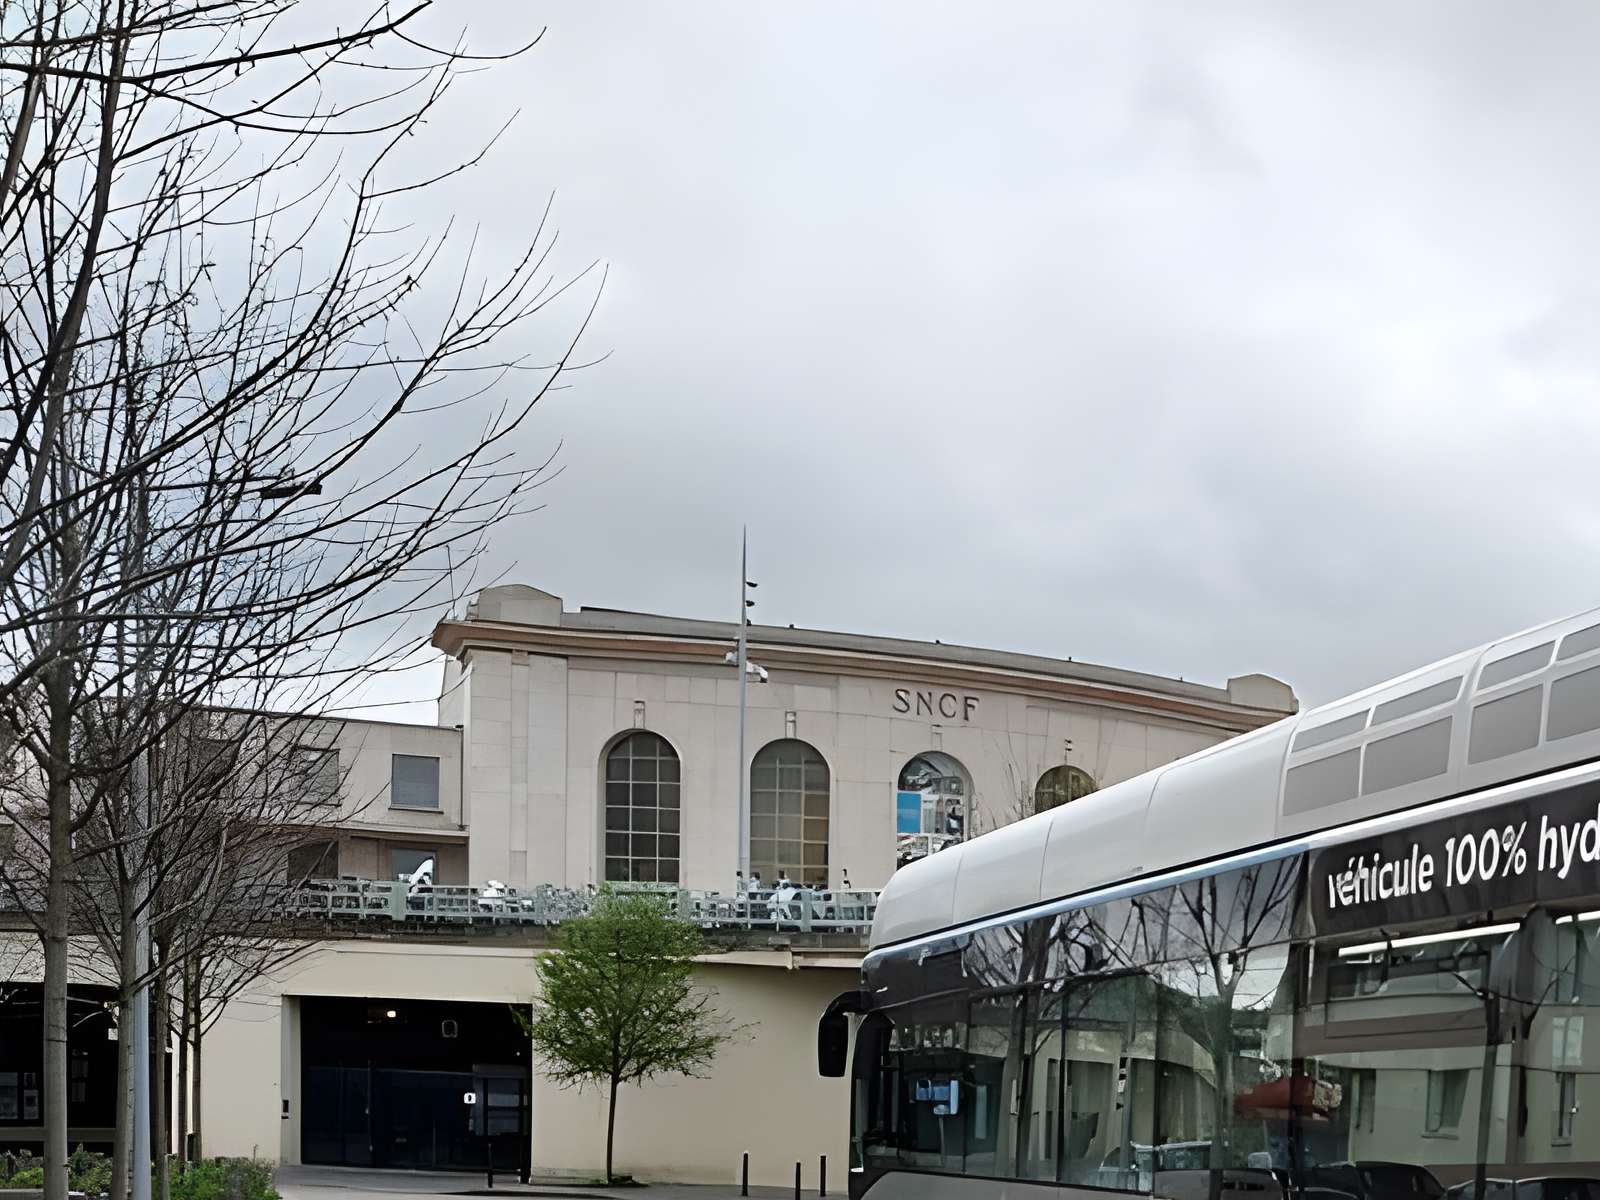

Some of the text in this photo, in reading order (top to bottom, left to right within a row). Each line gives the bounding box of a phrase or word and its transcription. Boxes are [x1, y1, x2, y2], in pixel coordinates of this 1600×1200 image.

[892, 688, 980, 722] SNCF
[1328, 843, 1434, 909] véhicule
[1445, 820, 1529, 888] 100%
